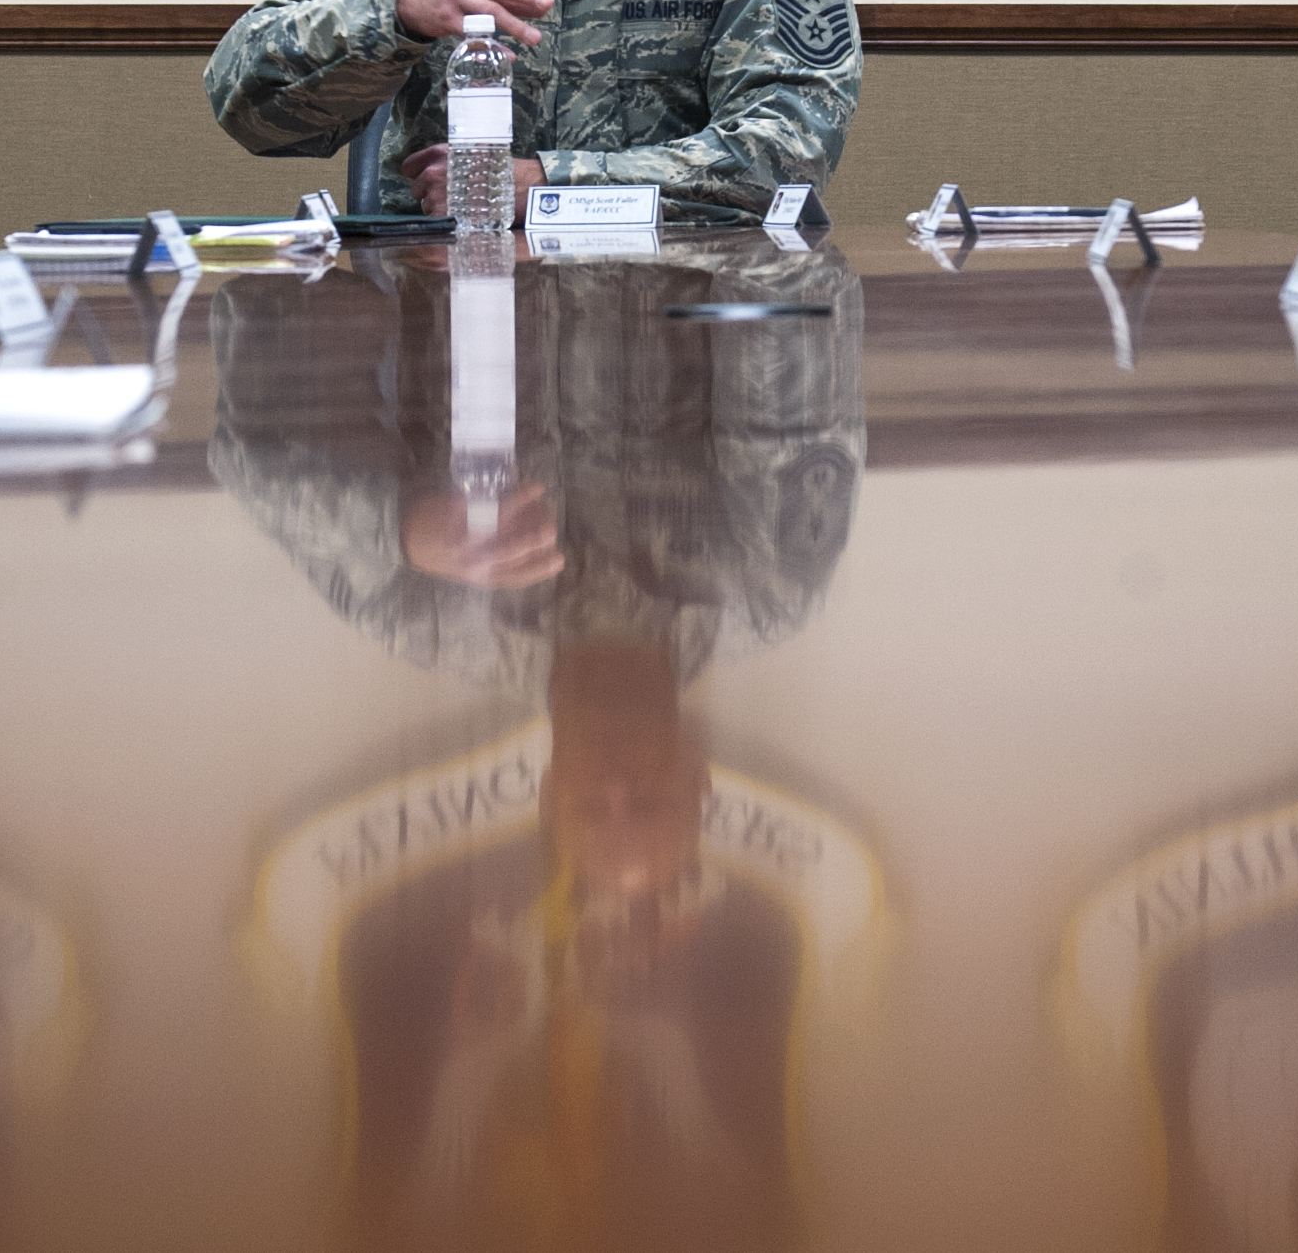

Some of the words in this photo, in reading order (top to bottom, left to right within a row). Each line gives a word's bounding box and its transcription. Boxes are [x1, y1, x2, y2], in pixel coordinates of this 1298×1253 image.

[651, 0, 680, 20] AIR
[683, 0, 722, 20] FORC
[569, 197, 594, 205] CMSgt
[616, 196, 639, 204] Fuller
